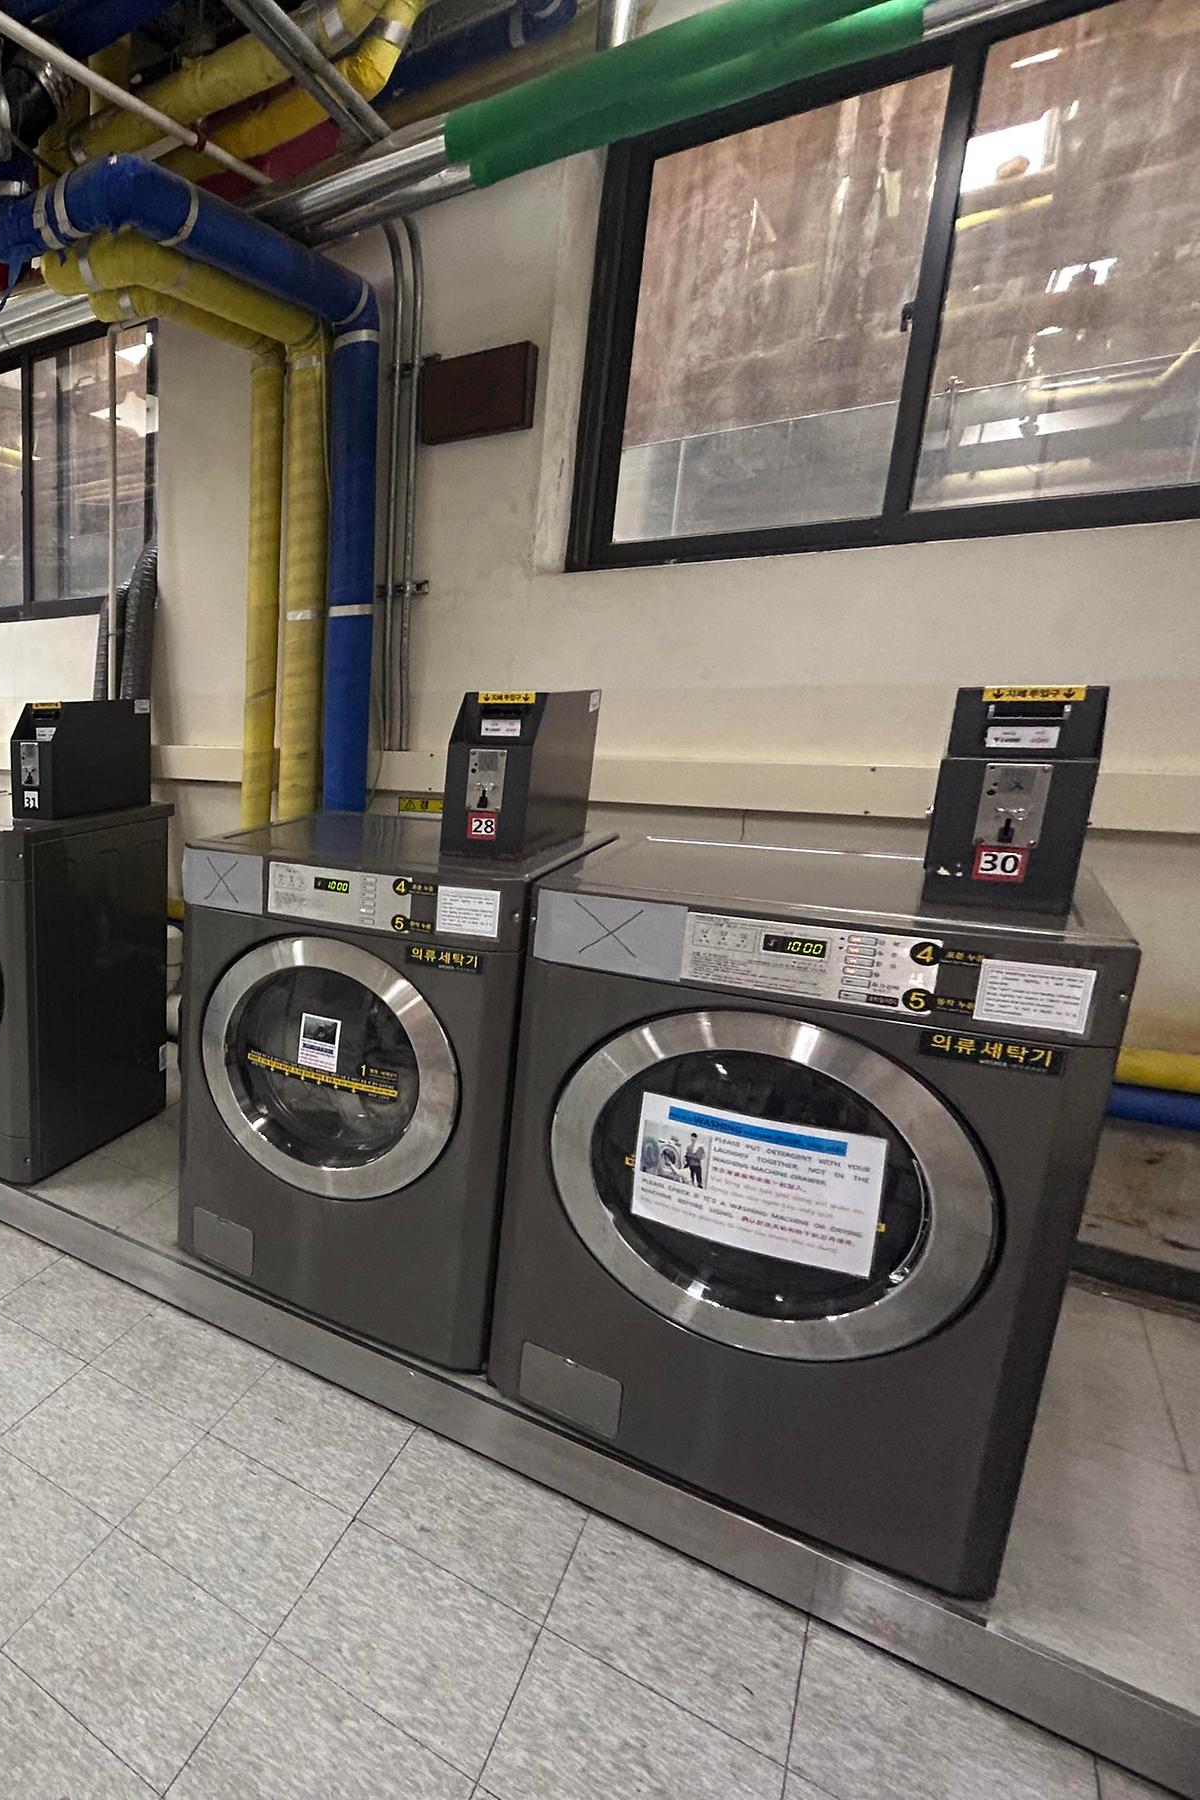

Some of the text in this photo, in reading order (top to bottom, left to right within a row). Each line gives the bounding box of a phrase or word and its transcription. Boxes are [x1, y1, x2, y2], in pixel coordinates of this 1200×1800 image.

[26, 796, 37, 808] 31
[472, 819, 494, 834] 28
[980, 853, 1019, 874] 30
[396, 880, 406, 893] 4
[395, 917, 405, 930] 5
[917, 946, 933, 962] 4
[909, 992, 926, 1009] 5
[930, 1034, 1053, 1067] 의류세탁기
[361, 1064, 367, 1077] 1
[808, 1166, 826, 1176] NOT
[853, 1174, 870, 1184] THE
